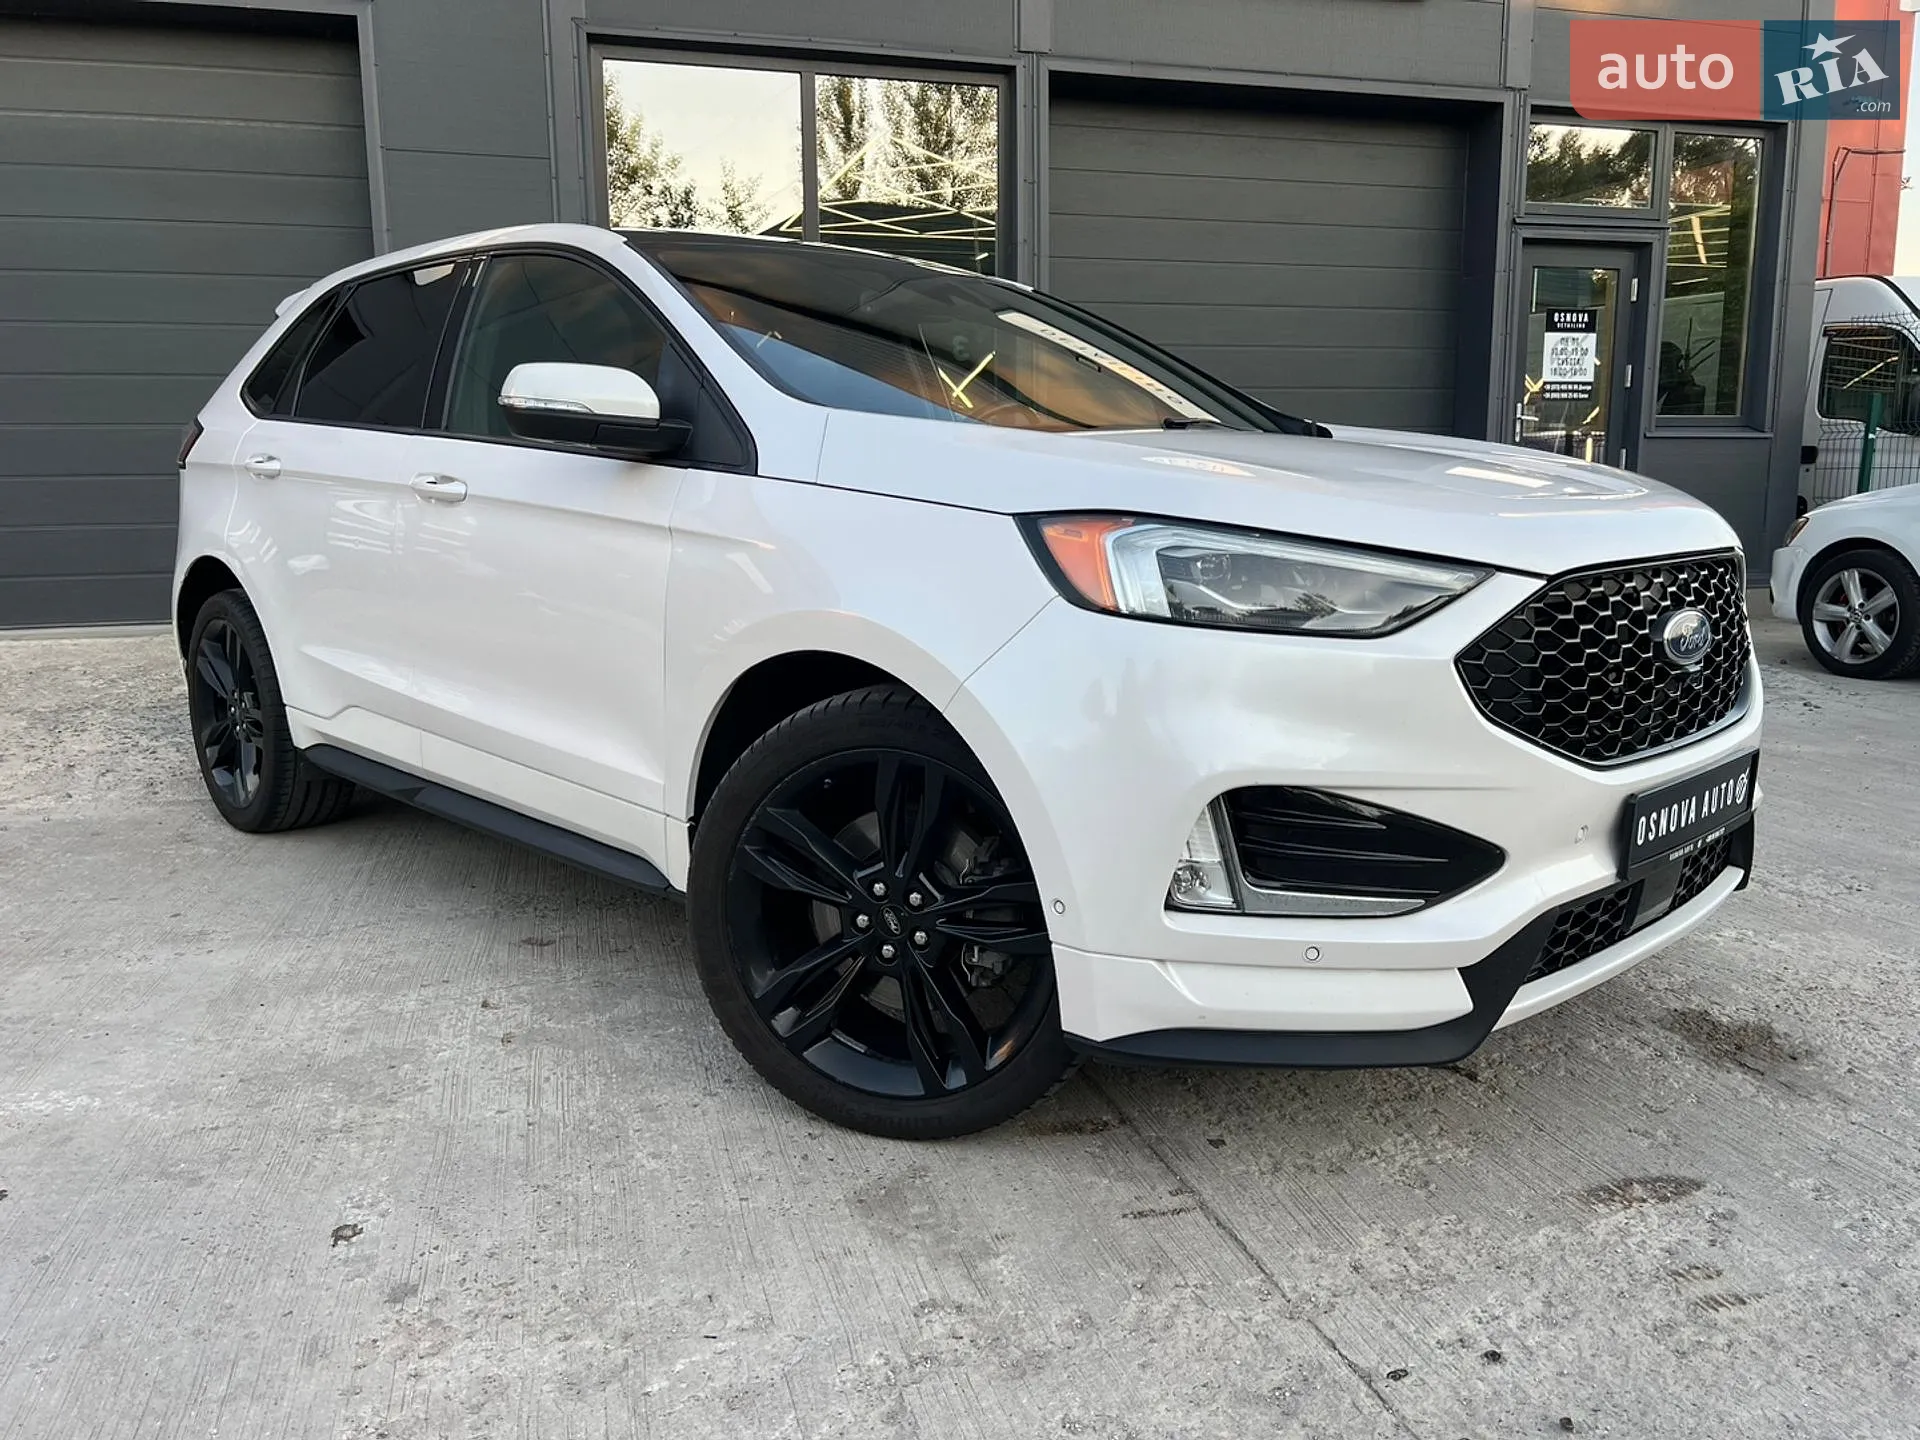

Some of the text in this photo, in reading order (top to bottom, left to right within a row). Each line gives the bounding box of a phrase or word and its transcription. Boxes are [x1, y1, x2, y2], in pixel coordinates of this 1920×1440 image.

[1553, 312, 1589, 323] OSNOVA
[1636, 795, 1696, 846] OSNOVA
[1701, 778, 1734, 819] AUTO
